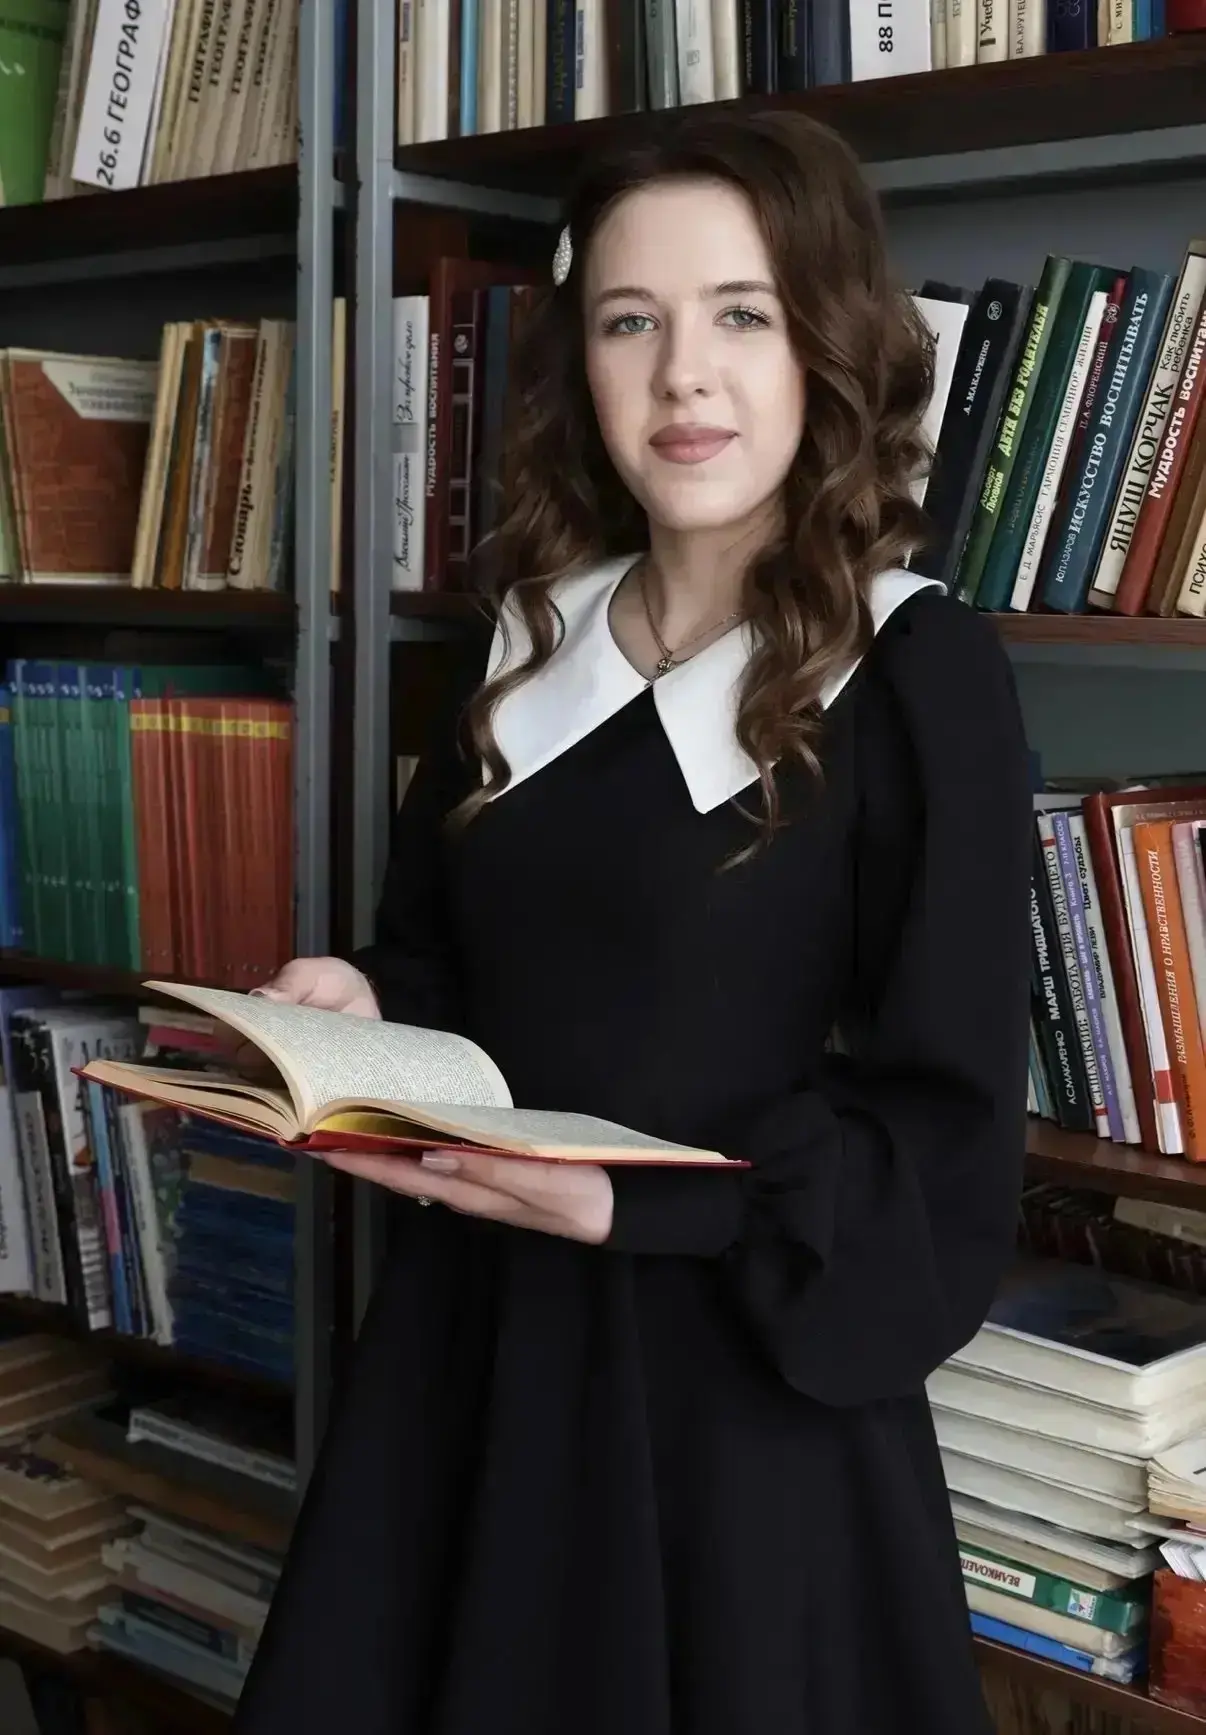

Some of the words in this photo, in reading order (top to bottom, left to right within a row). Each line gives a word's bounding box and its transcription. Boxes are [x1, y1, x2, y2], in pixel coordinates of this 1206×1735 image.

[878, 0, 893, 18] П
[879, 26, 893, 53] 88
[96, 126, 121, 186] 26.6
[1016, 302, 1049, 388] РОДИТЕЛЕЙ
[1160, 346, 1174, 371] Как
[1169, 293, 1190, 342] любить
[1170, 316, 1193, 373] ребенка
[966, 339, 991, 403] МАКАРЕНКО
[1086, 341, 1109, 408] ФЛОРЕНСКИЙ
[1008, 387, 1025, 416] БЕЗ
[1068, 433, 1107, 534] ИСКУССТВО
[1099, 292, 1148, 428] ВОСПИТЫВАТЬ
[998, 415, 1018, 457] ДЕТИ
[1026, 503, 1046, 557] МАРЬЯСИС
[1075, 326, 1093, 368] ЖИЗНИ
[985, 471, 1004, 514] Лиханов
[1110, 480, 1146, 553] ЯНУШ
[1132, 383, 1175, 476] КОРЧАК
[228, 483, 254, 576] Словарь
[1073, 836, 1087, 880] судьбы
[1046, 851, 1069, 926] БУДУЩЕГО
[1067, 881, 1078, 907] Книга
[1082, 883, 1092, 910] Цвет
[1147, 850, 1172, 956] НРАВСТВЕННОСТИ
[1060, 932, 1076, 959] ДЛЯ
[1088, 926, 1099, 950] ЛЕВИ
[1164, 957, 1174, 966] О
[1043, 976, 1060, 1020] МАРШ
[1067, 963, 1085, 1012] РАБОТА
[1092, 951, 1106, 999] ВЛАДИМИР
[1165, 970, 1187, 1064] РАЗМЫШЛЕНИЯ
